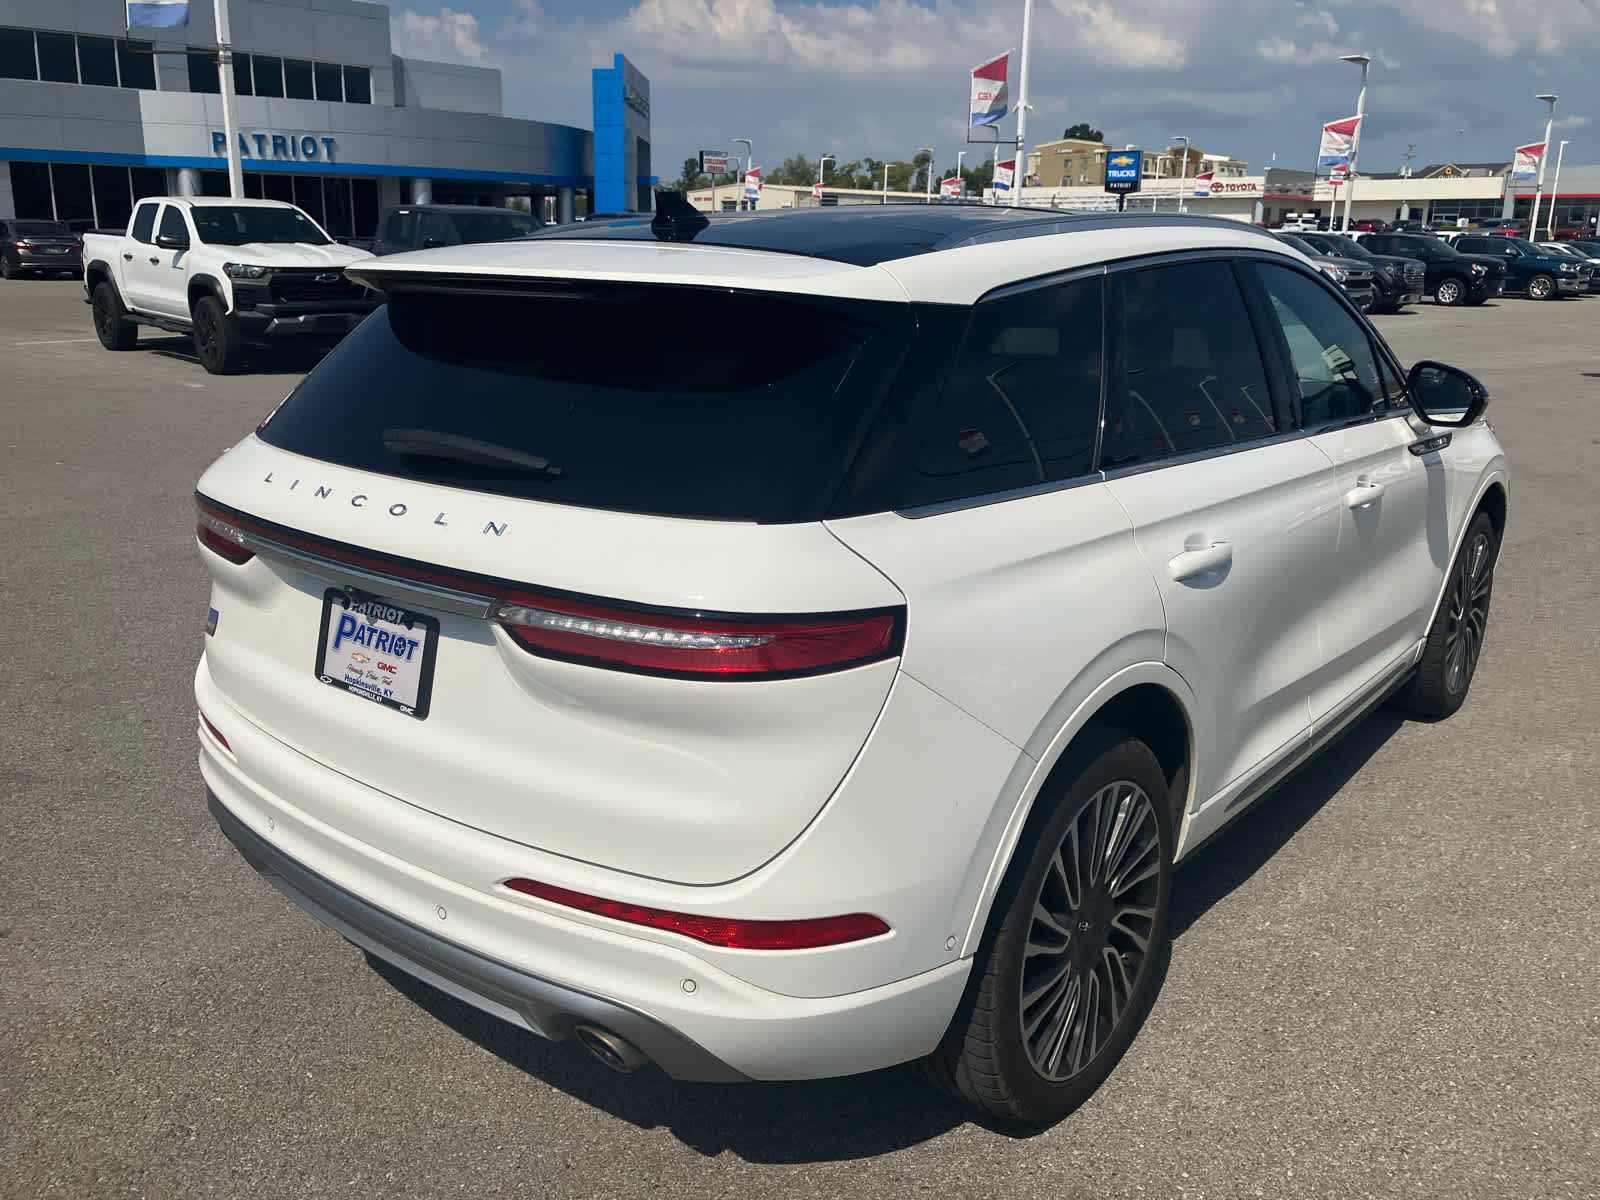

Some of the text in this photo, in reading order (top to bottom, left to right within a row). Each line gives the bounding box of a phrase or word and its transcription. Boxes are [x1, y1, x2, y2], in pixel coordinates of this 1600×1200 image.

[1108, 169, 1136, 178] TRUCKS
[1225, 183, 1257, 192] TOYOTA
[263, 472, 509, 537] LINCOLN
[350, 600, 405, 625] PATRIOT
[333, 612, 419, 661] PATRIOT
[377, 661, 398, 675] GMC
[383, 687, 394, 698] KY
[400, 704, 415, 715] GMC
